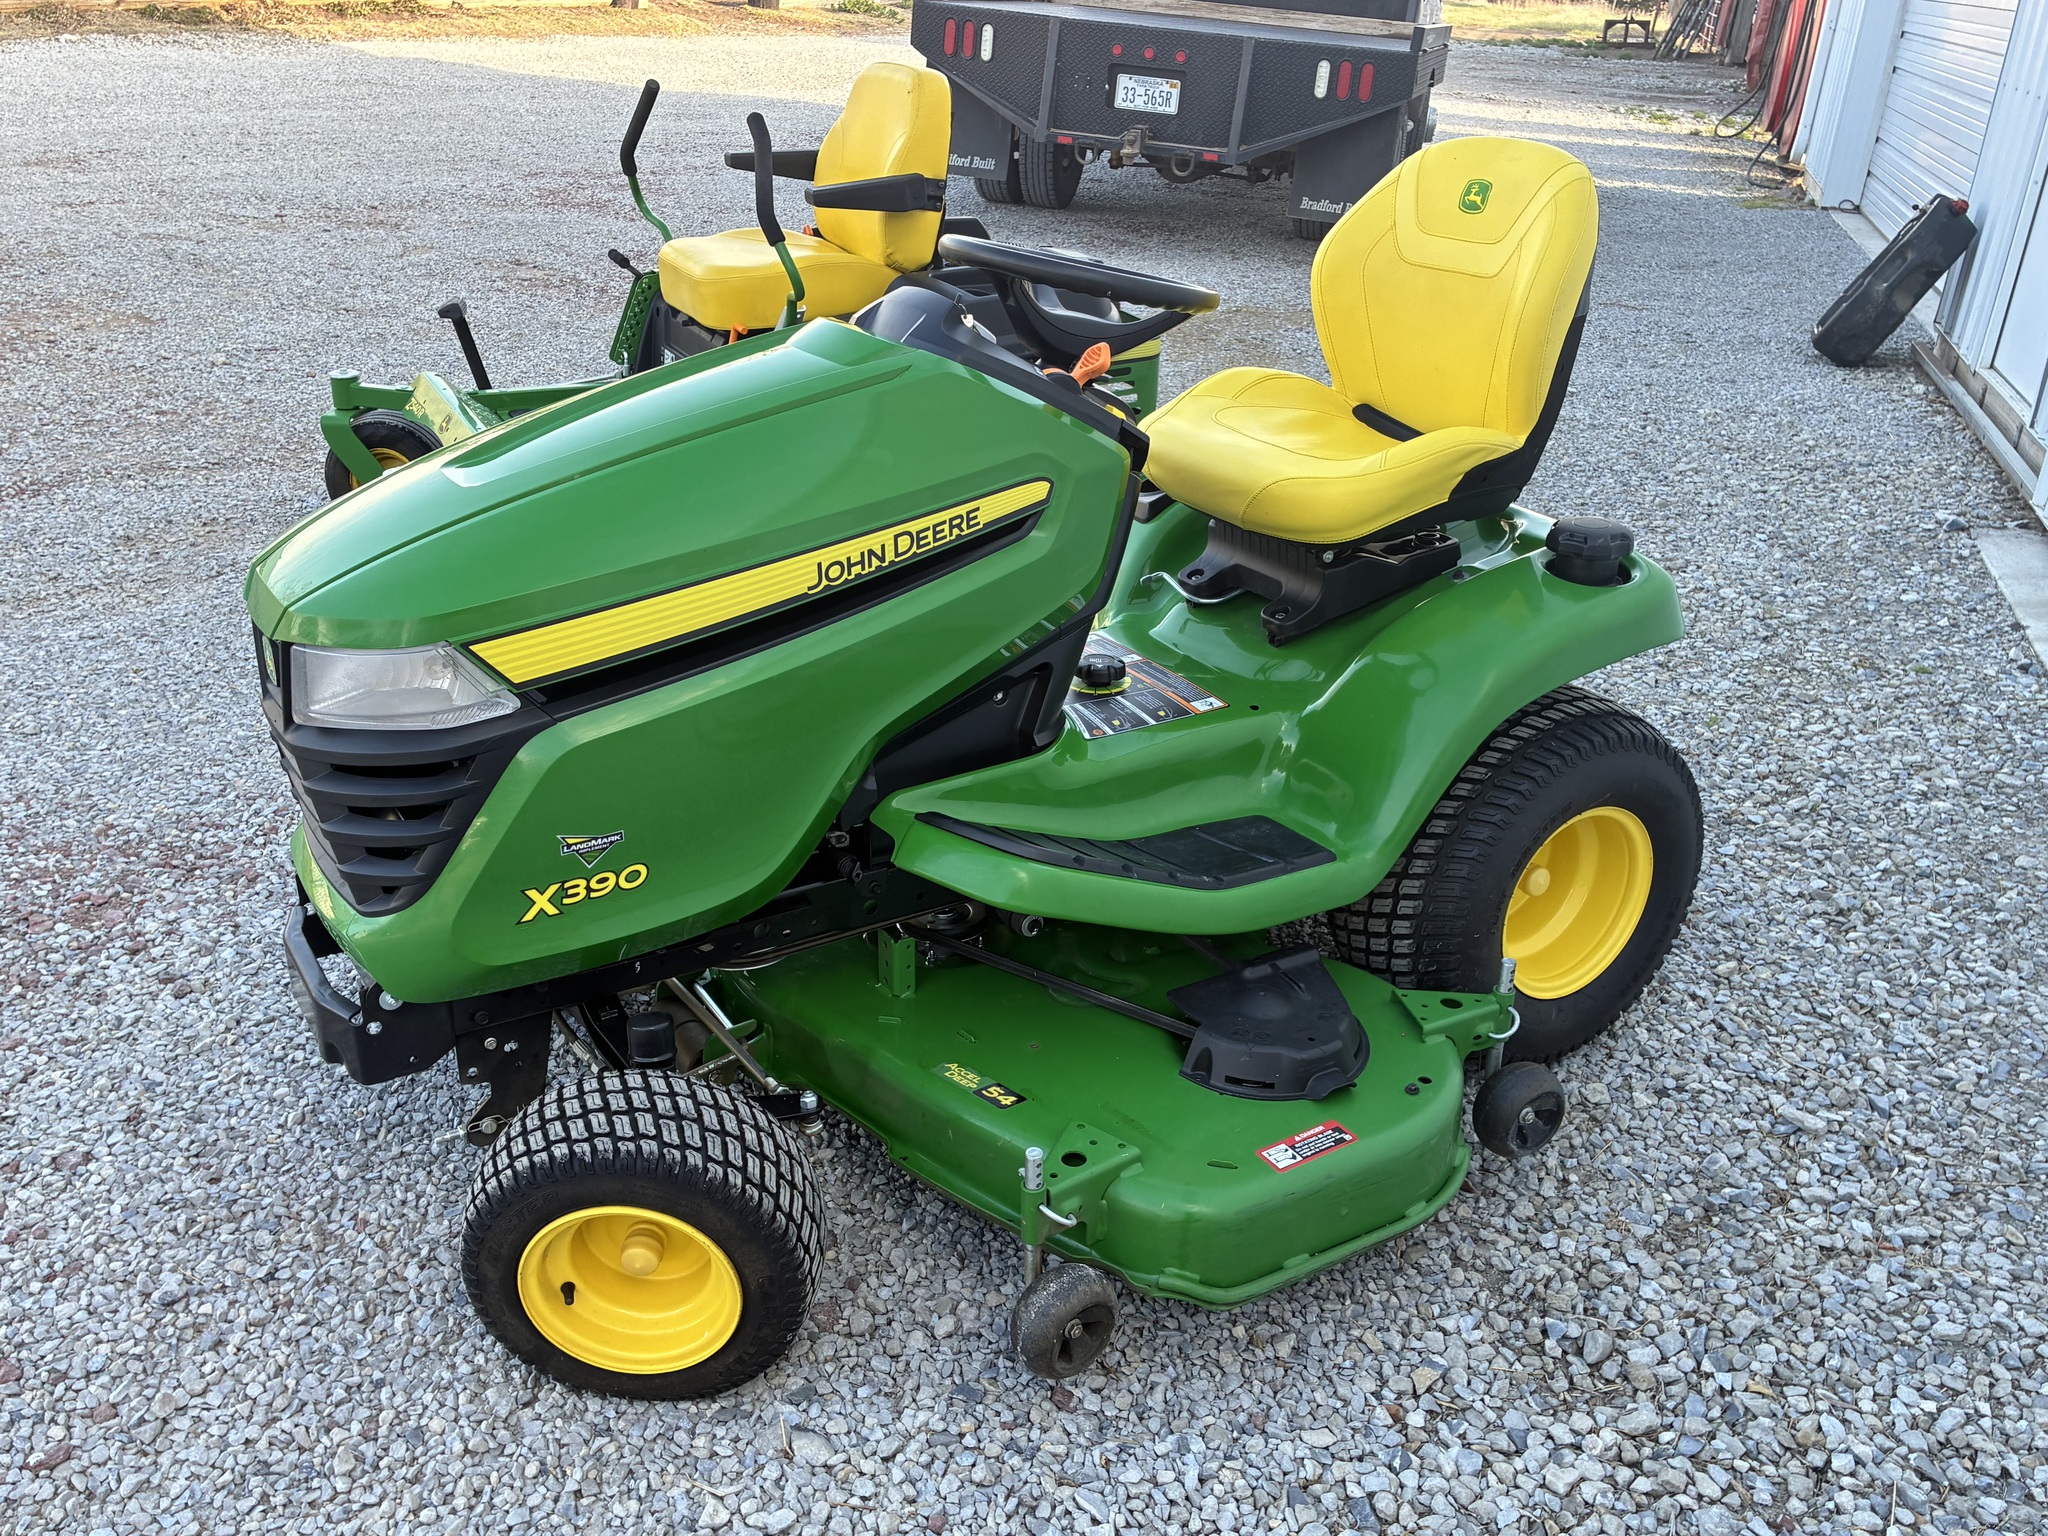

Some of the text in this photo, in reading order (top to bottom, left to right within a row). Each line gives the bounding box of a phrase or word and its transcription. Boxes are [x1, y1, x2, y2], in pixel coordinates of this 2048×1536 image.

[1134, 79, 1164, 87] NEBRASKA
[1122, 86, 1172, 108] 33-565R
[971, 156, 996, 170] Built
[1300, 196, 1344, 214] Bradford
[807, 506, 981, 593] JOHN DEERE
[563, 834, 622, 853] LANDMARK
[578, 843, 610, 854] IMPLEMENT
[517, 863, 648, 924] X390
[944, 1063, 981, 1084] ACCEL
[944, 1070, 978, 1089] DEEP
[981, 1086, 1018, 1106] 54
[1300, 1125, 1325, 1138] DANGER
